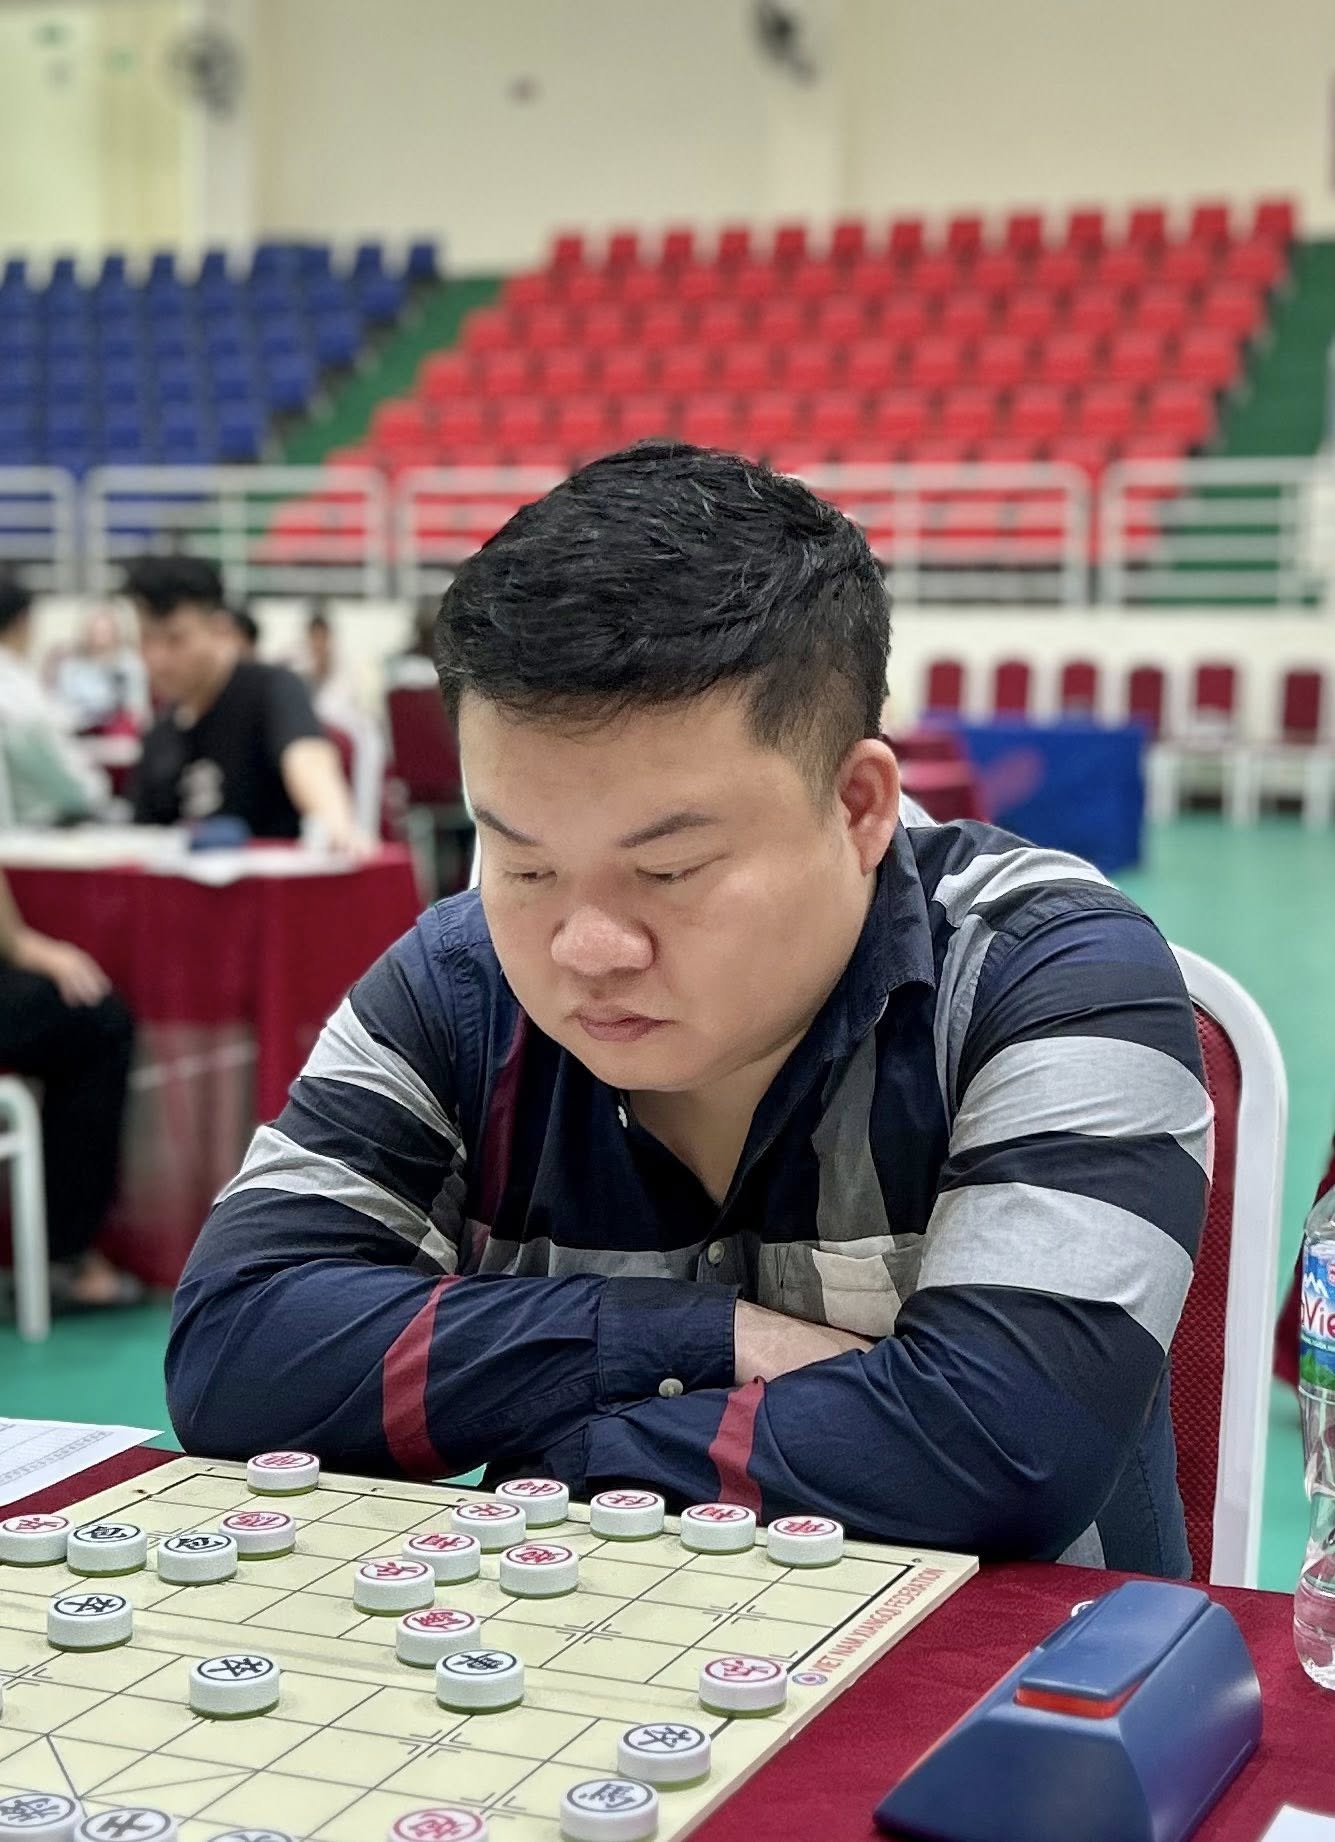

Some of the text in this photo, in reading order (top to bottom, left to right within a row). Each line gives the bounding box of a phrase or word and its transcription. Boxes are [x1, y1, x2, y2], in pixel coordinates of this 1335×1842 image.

[808, 1655, 845, 1673] VIET
[827, 1635, 868, 1656] NAM
[881, 1566, 946, 1608] FEDERATION
